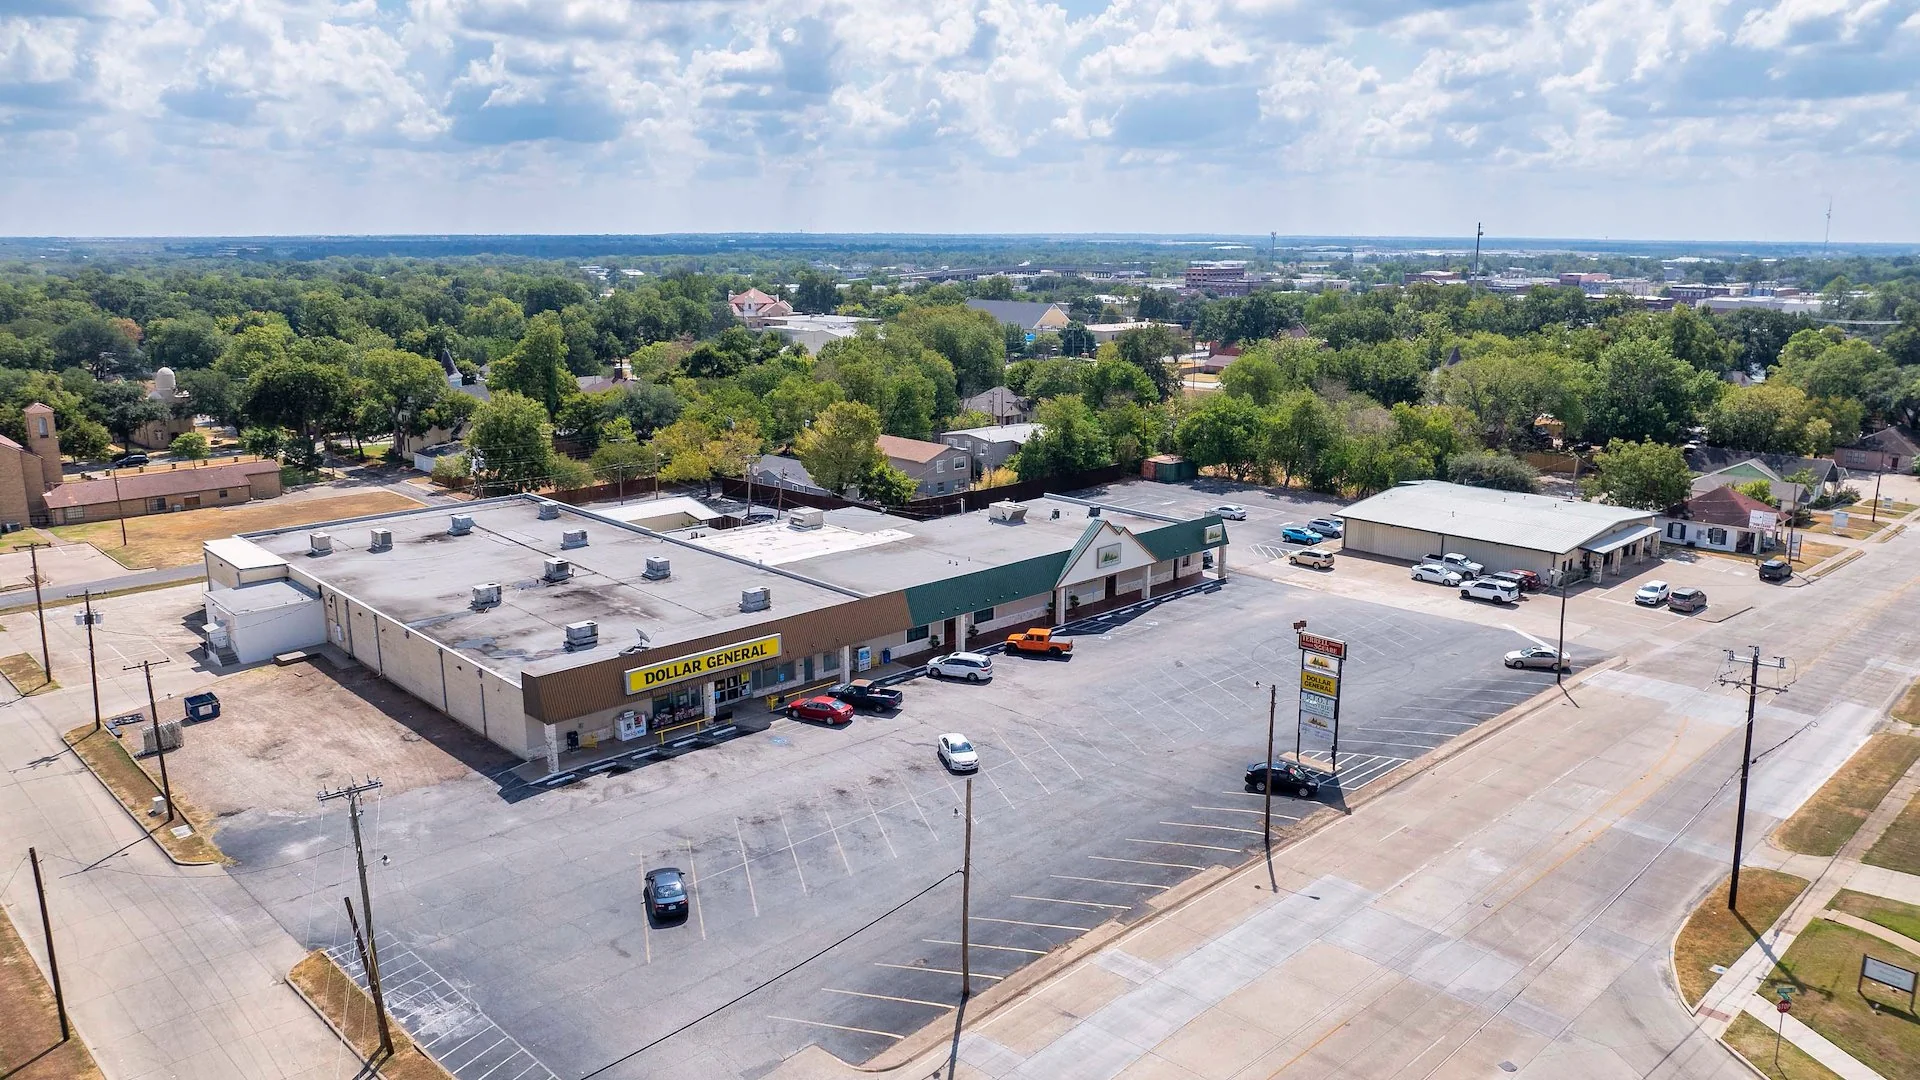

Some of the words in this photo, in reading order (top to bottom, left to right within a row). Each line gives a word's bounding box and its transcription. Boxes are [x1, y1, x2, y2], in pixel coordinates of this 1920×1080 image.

[1301, 634, 1329, 646] TERRELL
[1313, 643, 1338, 655] SQUARE
[644, 660, 702, 684] DOLLAR
[706, 644, 767, 668] GENERAL
[1306, 675, 1332, 686] DOLLAR
[1304, 680, 1333, 694] GENERAL
